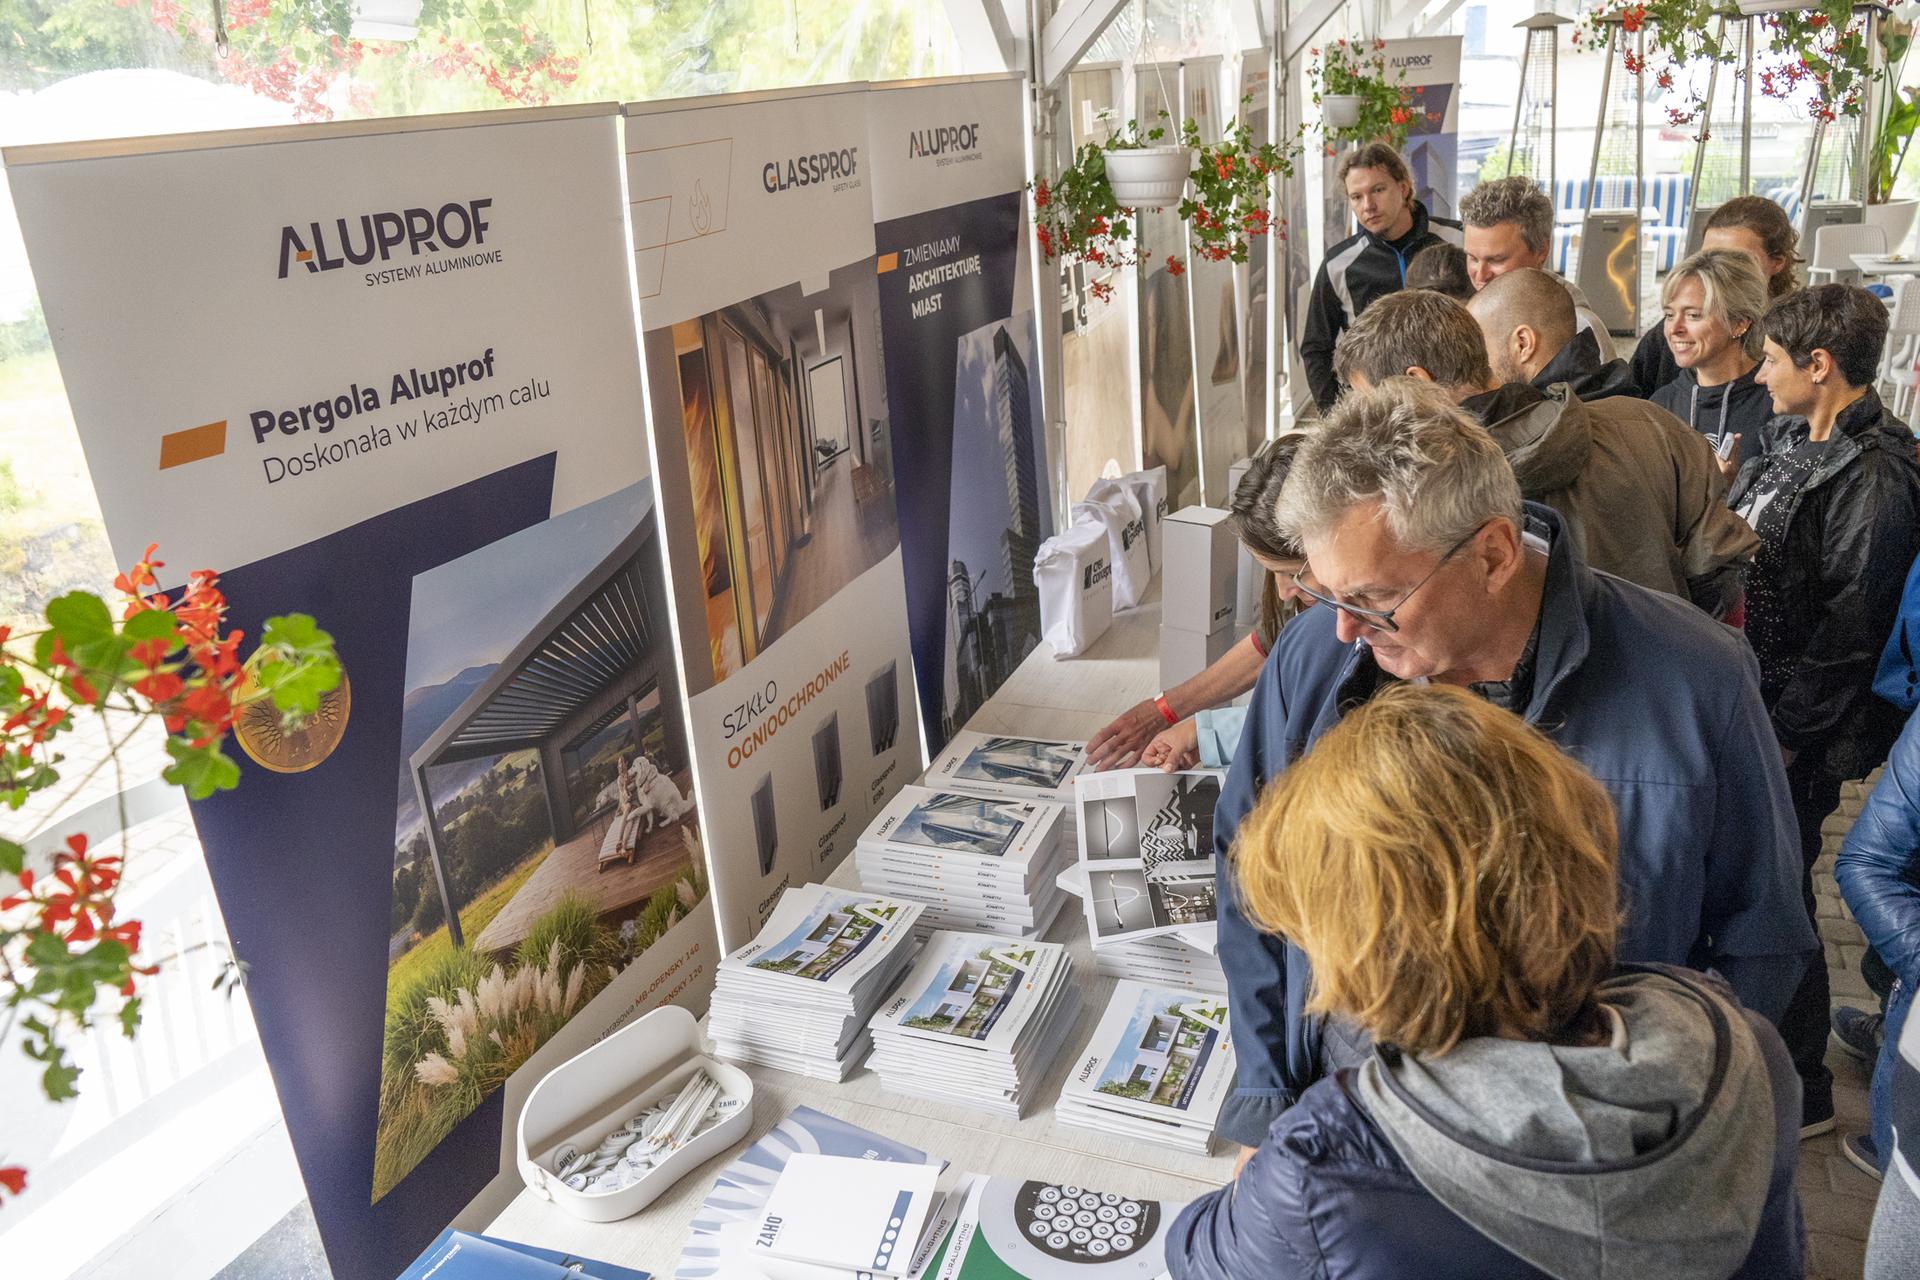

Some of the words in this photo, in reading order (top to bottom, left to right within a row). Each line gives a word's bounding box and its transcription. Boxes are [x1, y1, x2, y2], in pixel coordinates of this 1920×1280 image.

[1390, 55, 1432, 68] ALUPROF
[909, 123, 979, 159] ALUPROF
[762, 147, 858, 194] GLASSPROF
[278, 198, 492, 279] ALUPROF
[903, 235, 961, 268] ZMIENIAMY
[365, 265, 422, 287] SYSTEMY
[425, 249, 503, 277] ALUMINIOWE
[908, 254, 982, 294] ARCHITEKTURĘ
[911, 293, 943, 320] MIAST
[250, 384, 380, 444] Pergola
[390, 347, 495, 405] Aluprof
[263, 424, 392, 485] Doskonała
[396, 417, 418, 441] w
[423, 391, 504, 433] każdym
[508, 377, 551, 407] calu
[722, 679, 778, 740] SZKŁO
[726, 649, 851, 770] OGNIOOCHRONNE
[870, 759, 897, 793] Glassprof
[818, 811, 848, 850] Glassprof
[758, 872, 789, 914] Glassprof
[634, 958, 685, 1008] MB-OPENSKY
[686, 943, 700, 962] 140
[688, 964, 703, 983] 120
[1078, 1056, 1099, 1083] ALUPROF
[718, 1099, 738, 1108] ZAHO
[611, 1131, 631, 1139] ZAHO
[558, 1150, 577, 1170] ZAHO
[755, 1215, 783, 1248] ZAHO
[914, 1218, 947, 1270] LIRALIGHTING
[946, 1223, 970, 1276] LIRALIGHTING
